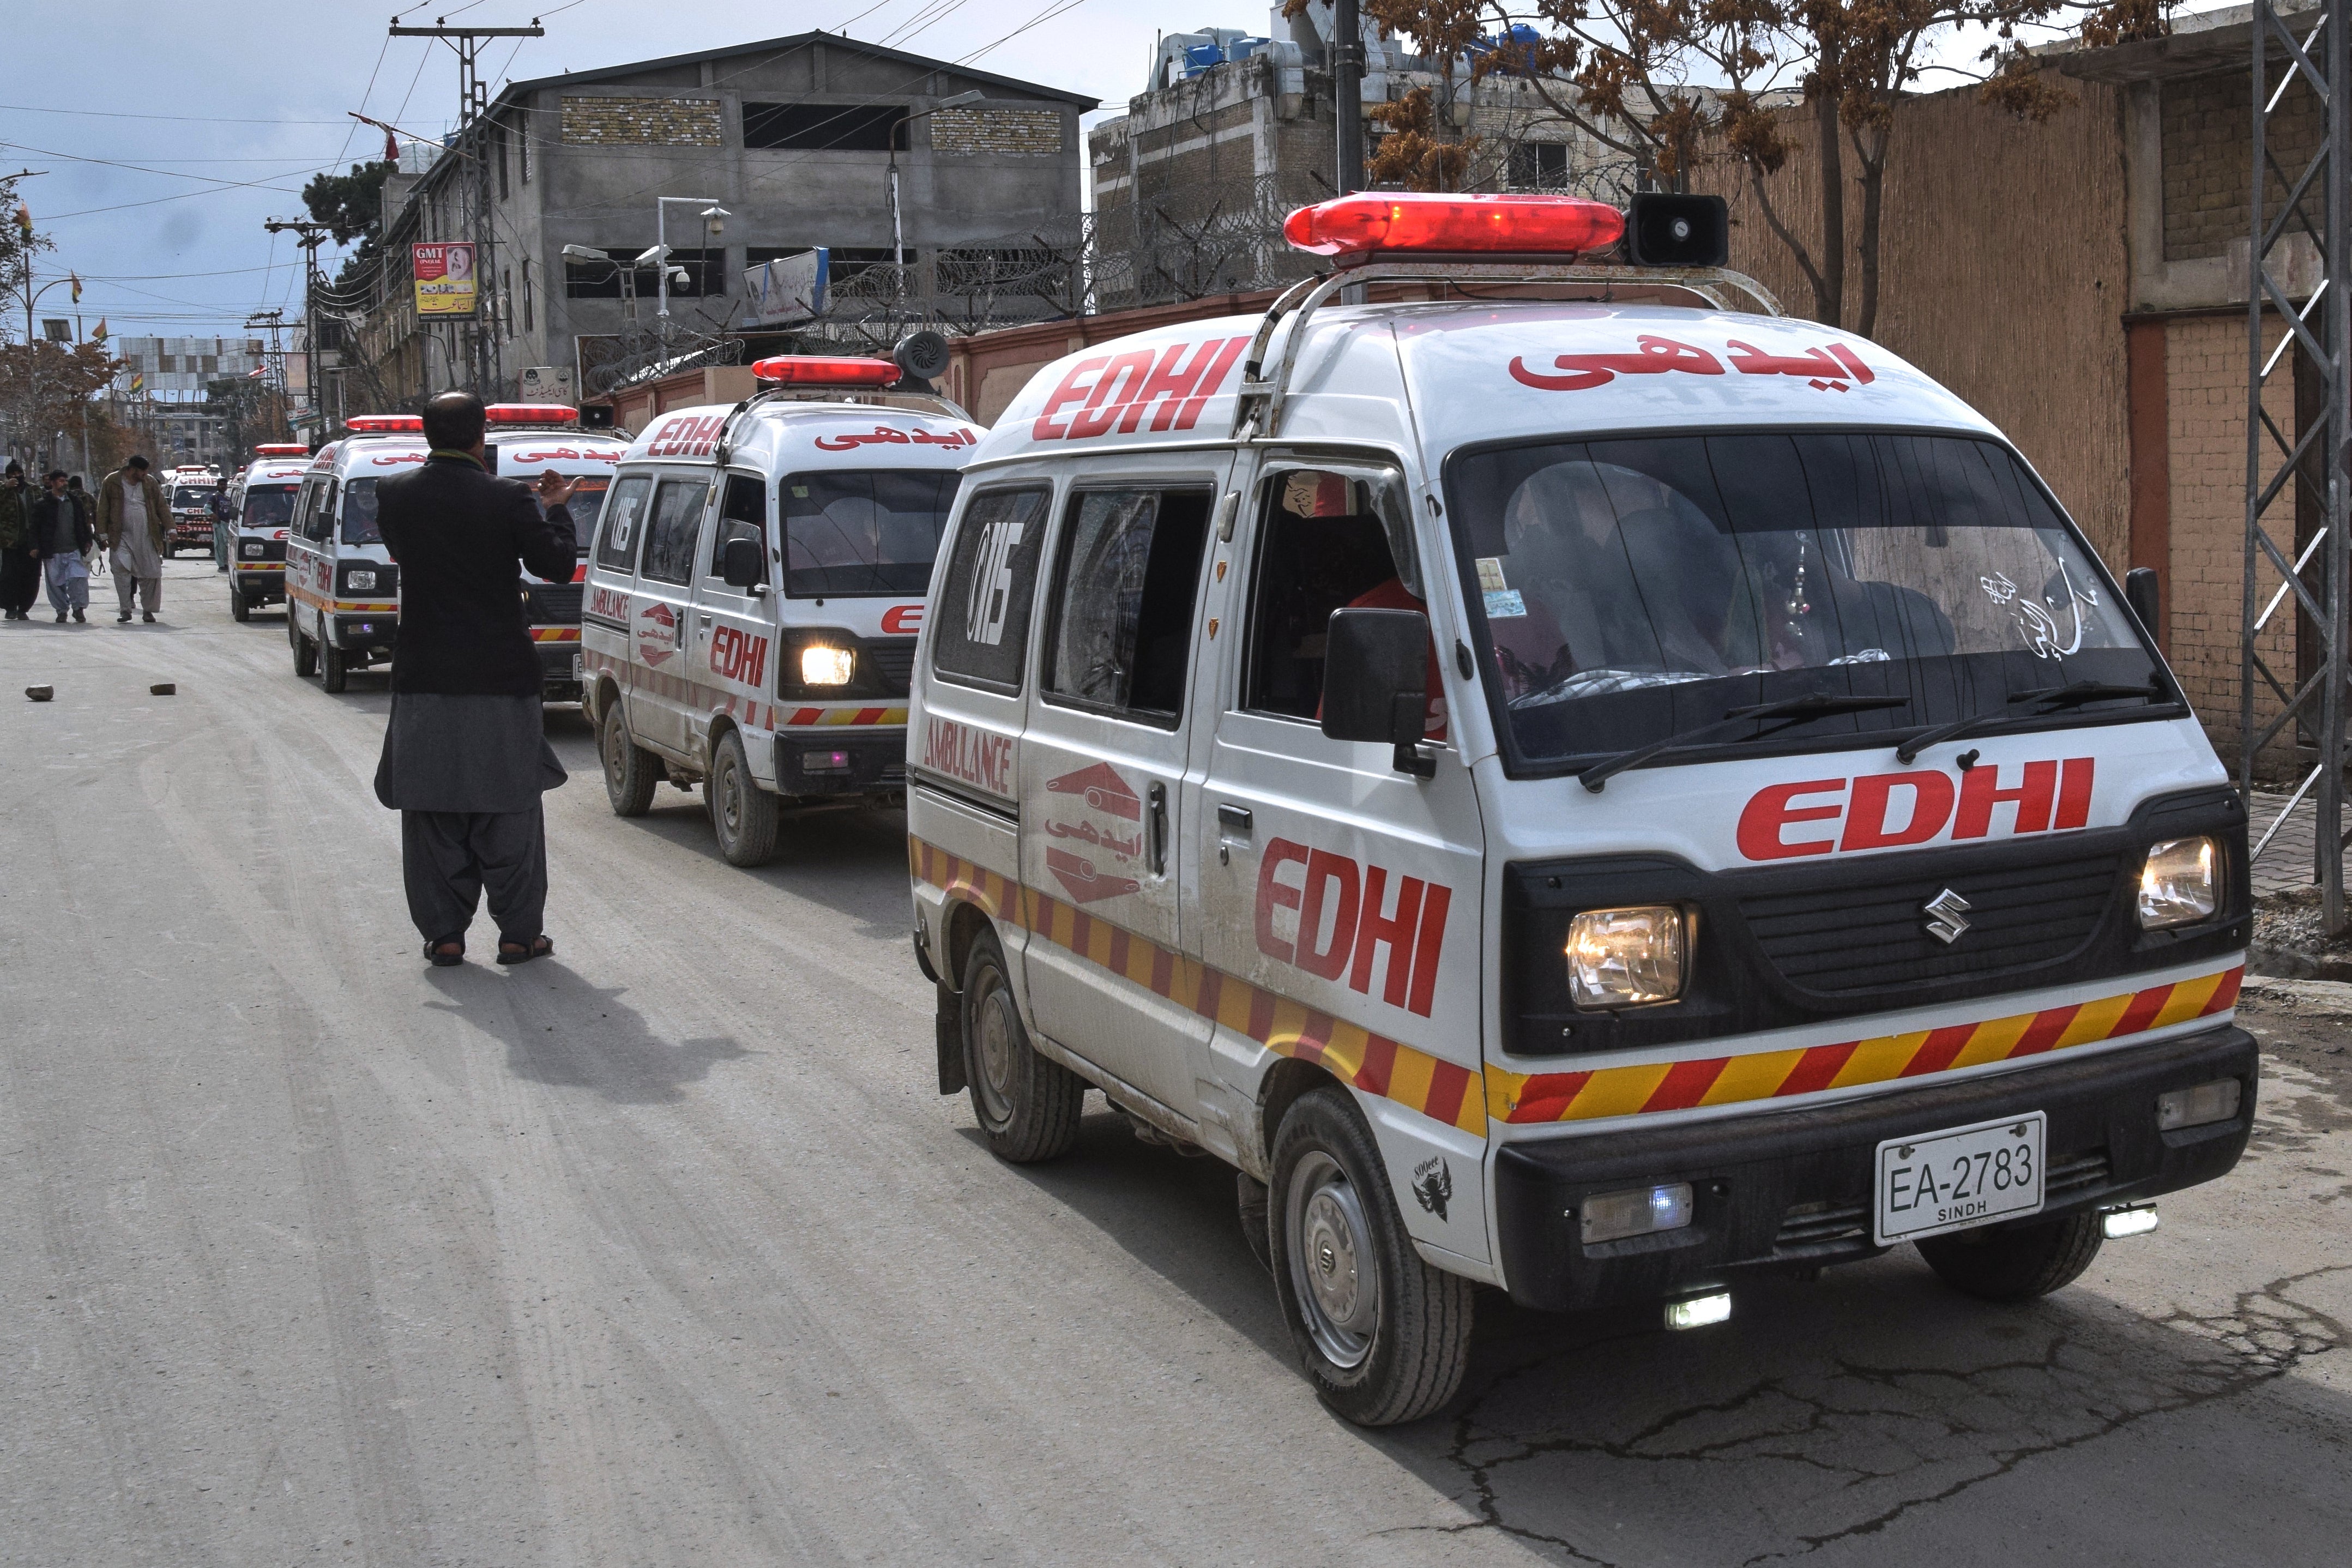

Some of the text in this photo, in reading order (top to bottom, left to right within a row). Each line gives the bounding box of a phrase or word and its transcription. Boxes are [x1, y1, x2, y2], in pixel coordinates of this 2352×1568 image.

[417, 248, 444, 258] GMT
[1032, 335, 1253, 441] EDHI
[648, 416, 725, 456] EDHI
[590, 587, 630, 620] AMBULANCE
[710, 625, 768, 688] EDHI
[924, 716, 1012, 794] AMBULANCE
[1736, 757, 2095, 861] EDHI
[1255, 836, 1452, 1018] EDHI
[1890, 1144, 2033, 1213] EA-2783
[1937, 1200, 1987, 1222] SINDH
